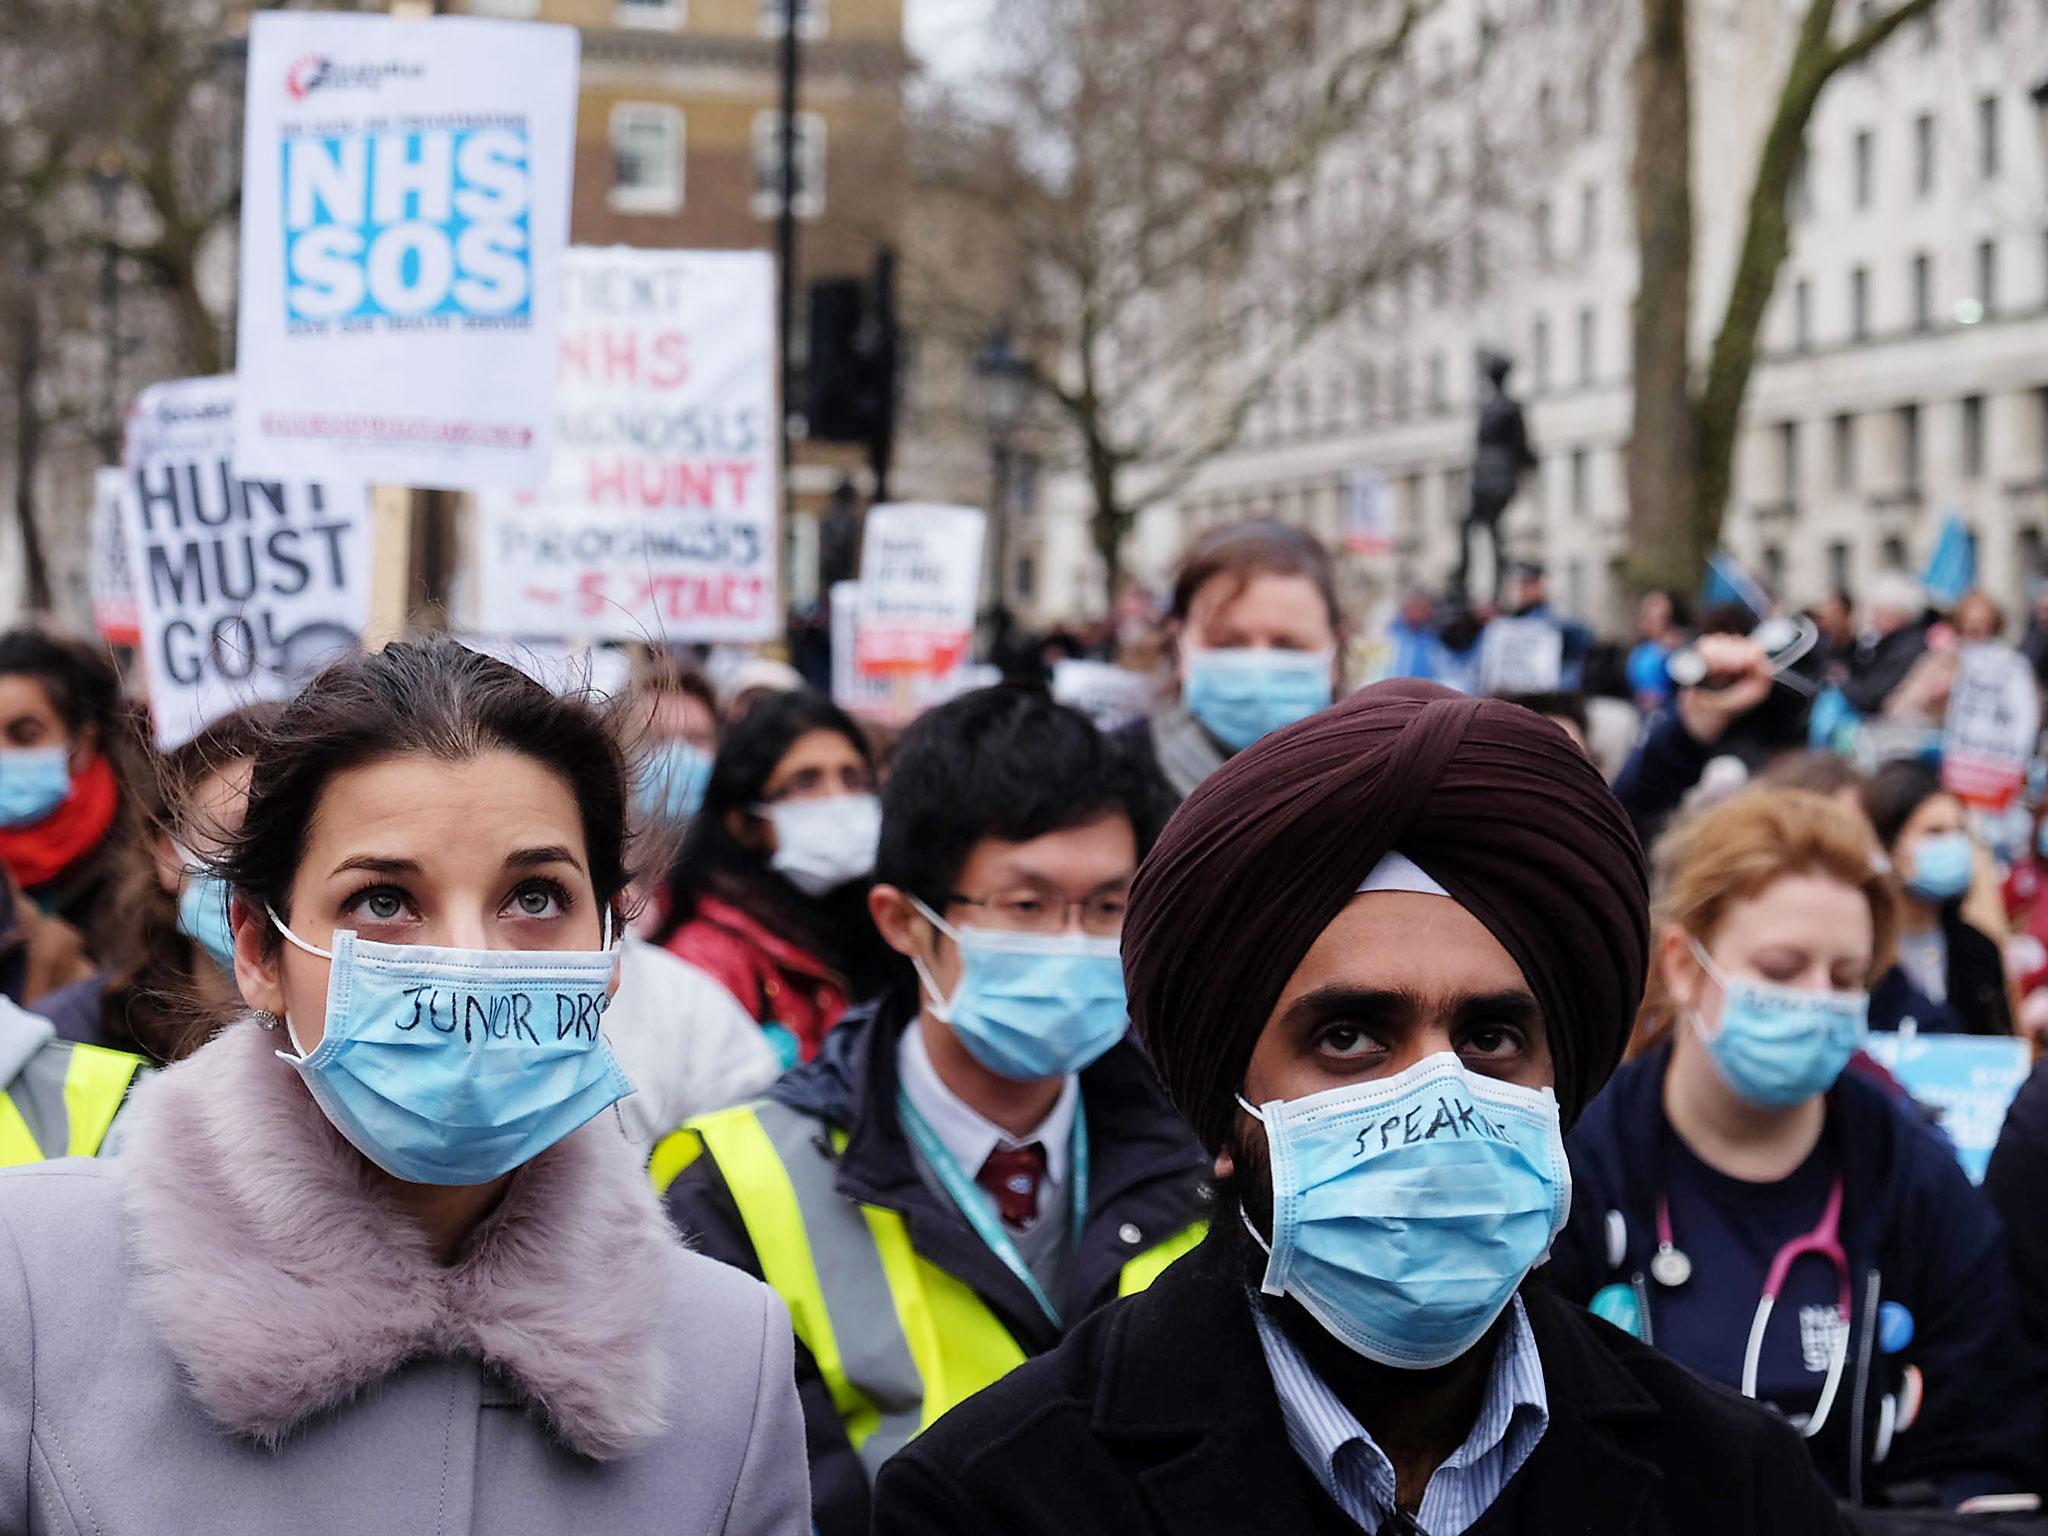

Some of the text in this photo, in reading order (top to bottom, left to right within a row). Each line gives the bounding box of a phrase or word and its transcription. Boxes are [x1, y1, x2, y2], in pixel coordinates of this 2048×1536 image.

[288, 129, 529, 224] NHS
[289, 221, 529, 321] SOS
[559, 326, 691, 390] NHS
[586, 457, 755, 508] HUNT
[145, 522, 353, 608] MUST
[394, 984, 541, 1046] JUNIOR
